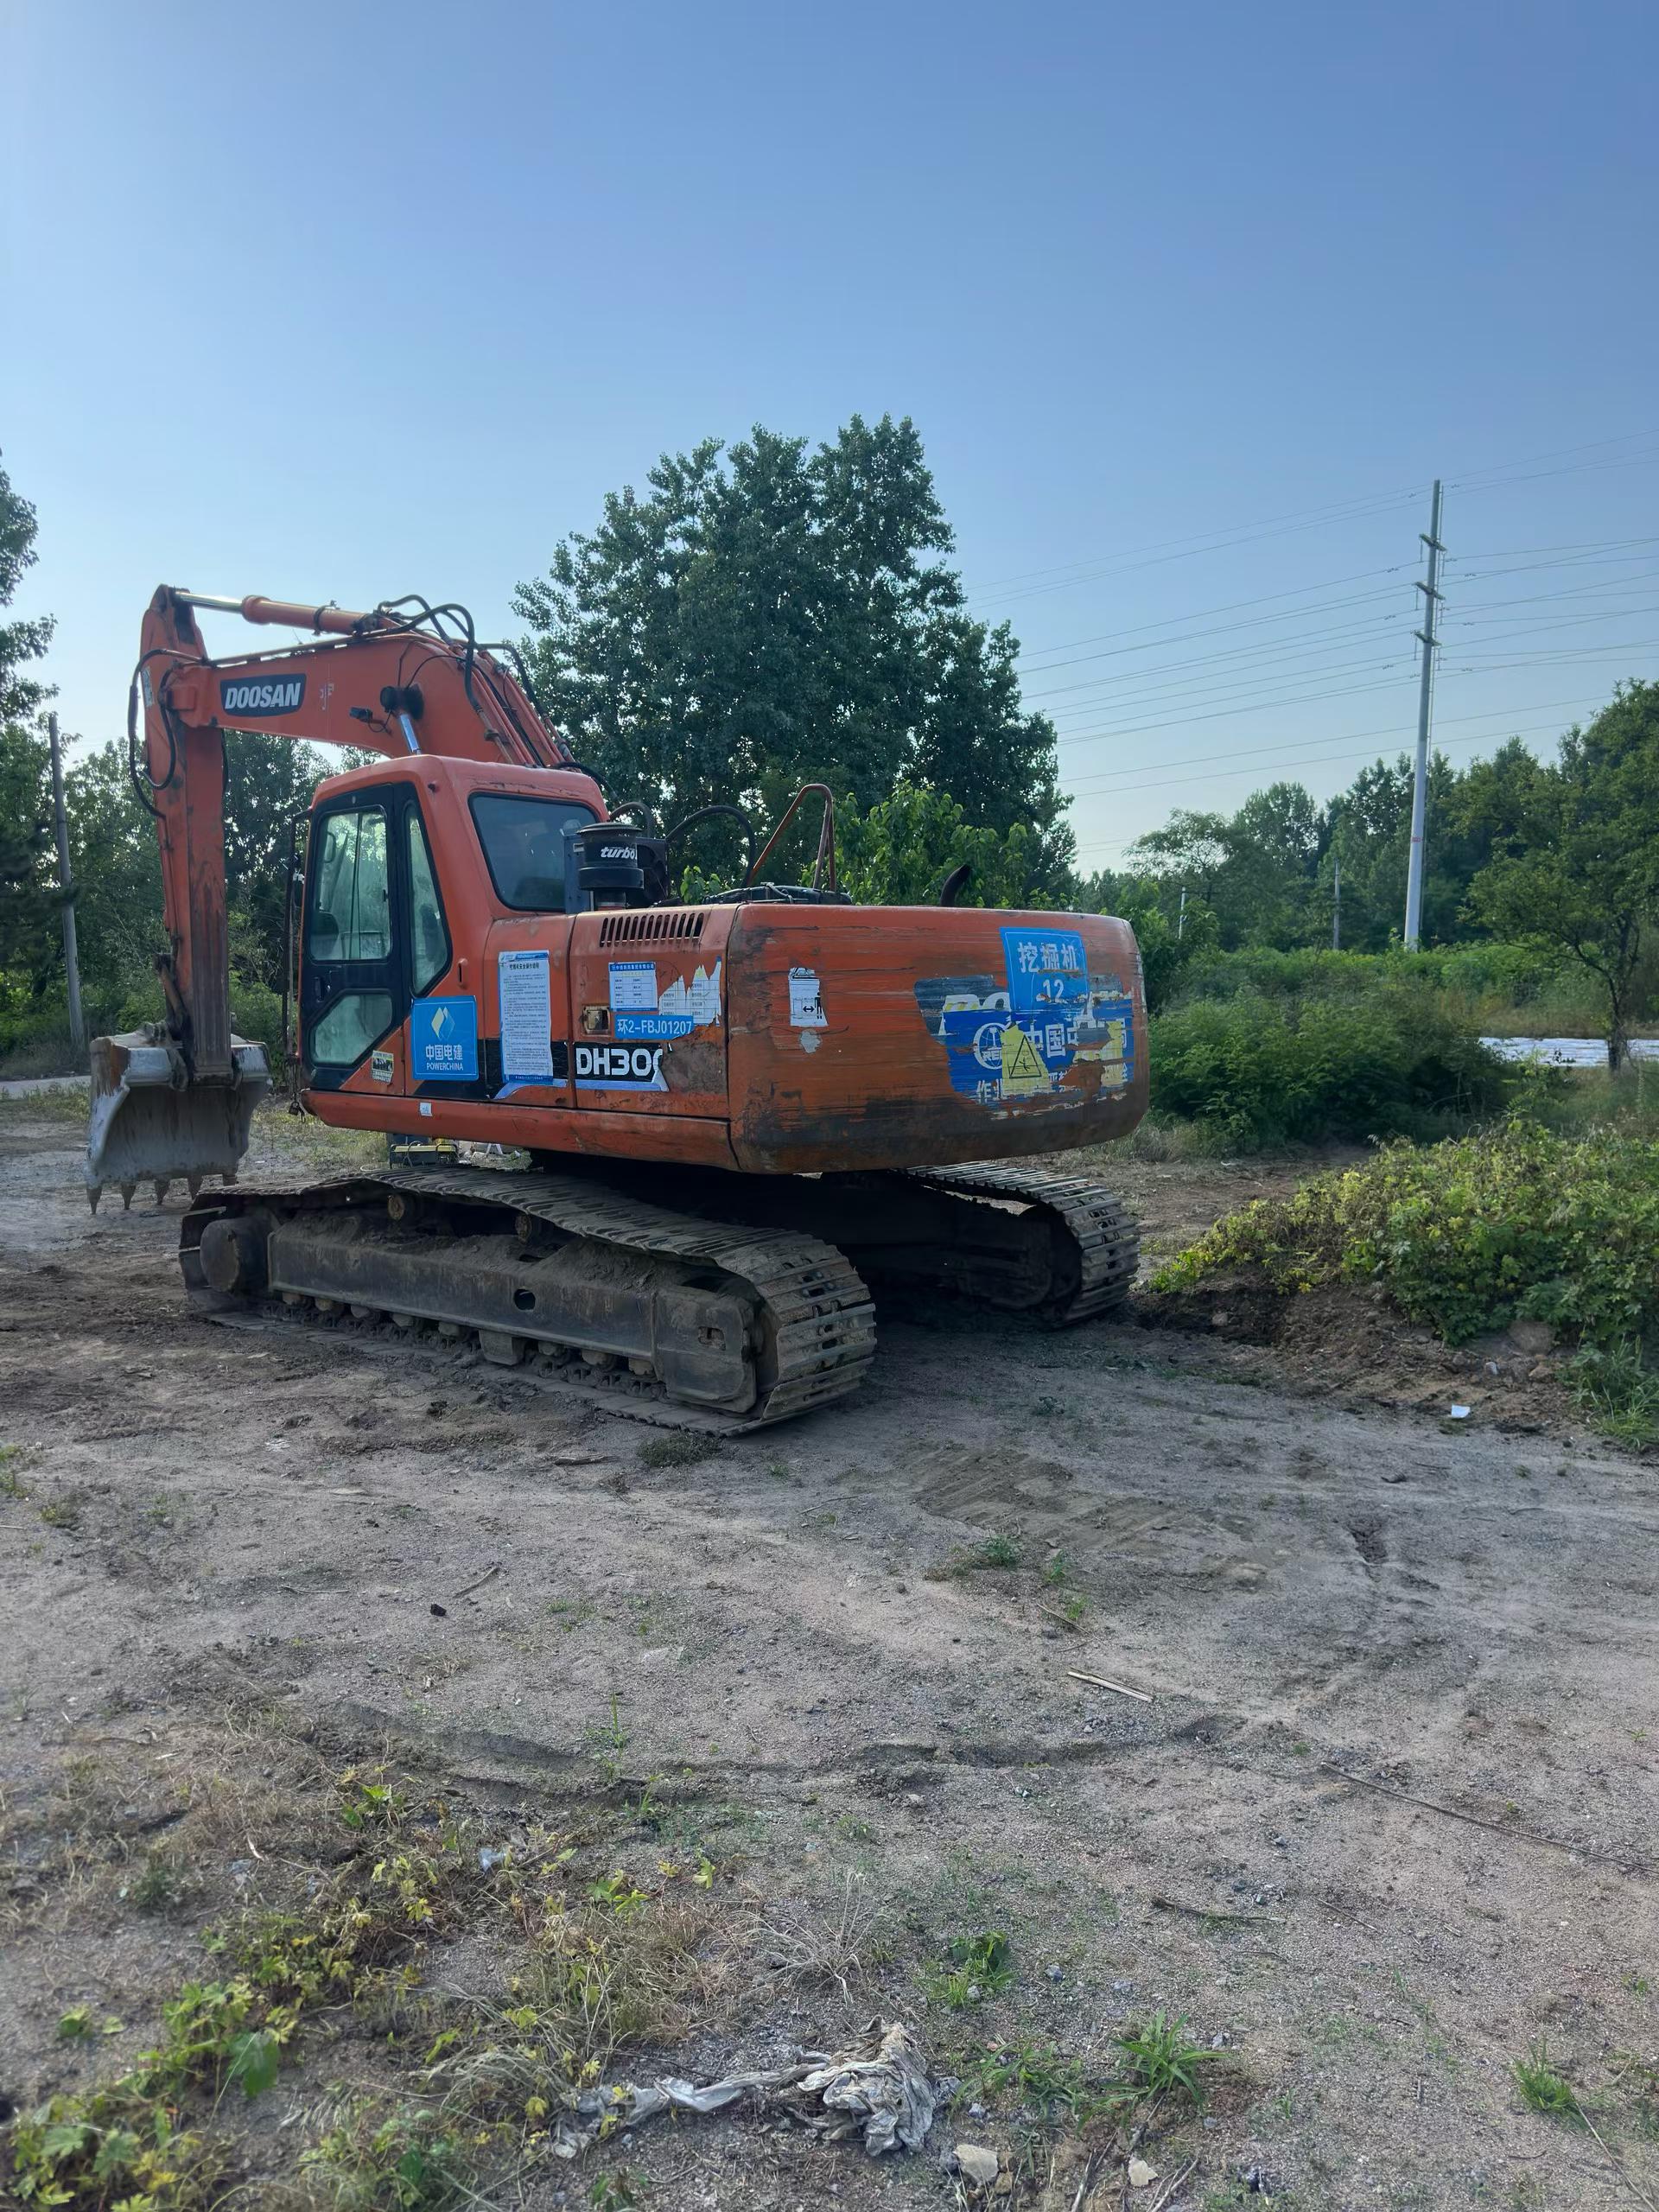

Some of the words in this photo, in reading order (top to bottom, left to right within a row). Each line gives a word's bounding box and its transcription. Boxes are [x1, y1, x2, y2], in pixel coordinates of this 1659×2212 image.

[225, 683, 302, 709] DOOSAN
[601, 847, 636, 860] turbo
[1017, 942, 1079, 973] 挖掘机
[1043, 979, 1069, 1003] 12
[617, 1019, 692, 1035] 环2-FBJ01207
[425, 1044, 463, 1061] 中国电建
[426, 1062, 464, 1071] POWERCHINA
